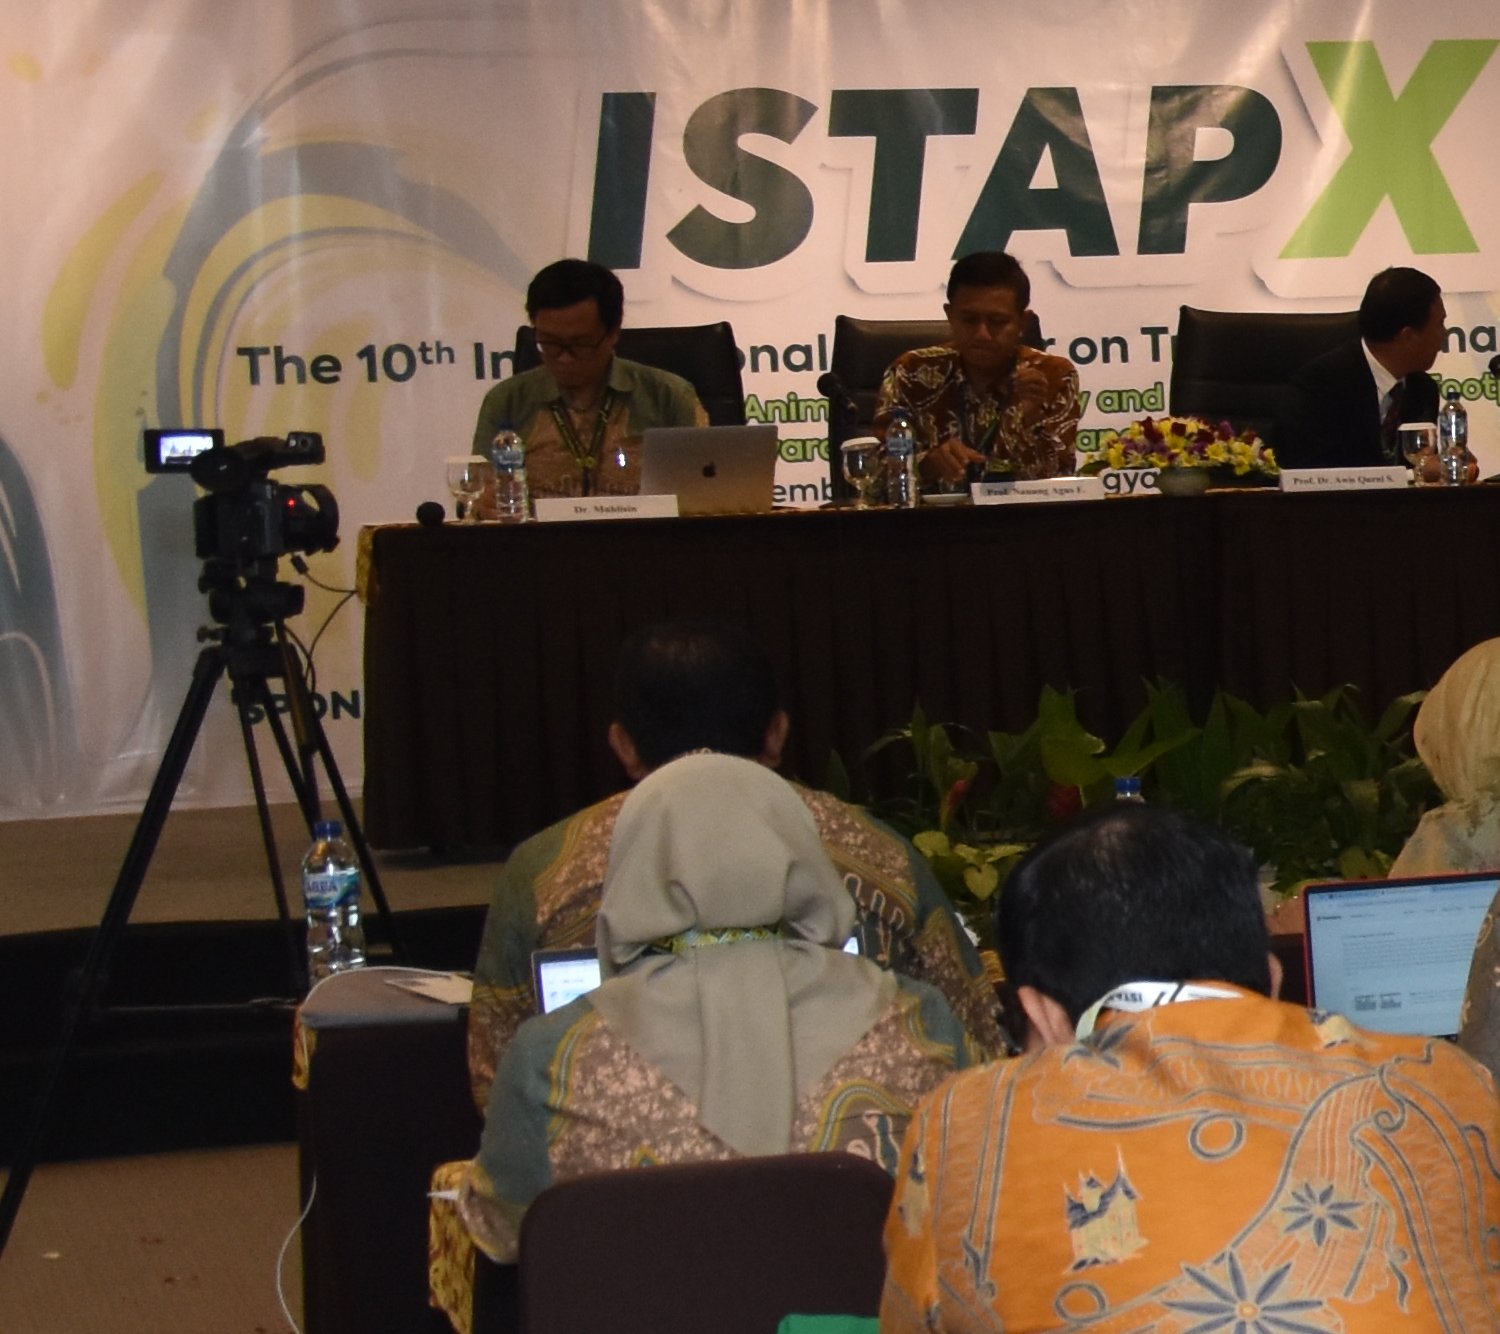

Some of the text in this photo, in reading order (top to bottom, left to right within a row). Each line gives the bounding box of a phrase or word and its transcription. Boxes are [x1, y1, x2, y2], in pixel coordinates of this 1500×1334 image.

[237, 345, 343, 386] The
[356, 340, 455, 384] 10th
[1069, 336, 1129, 365] on
[1096, 381, 1164, 414] and
